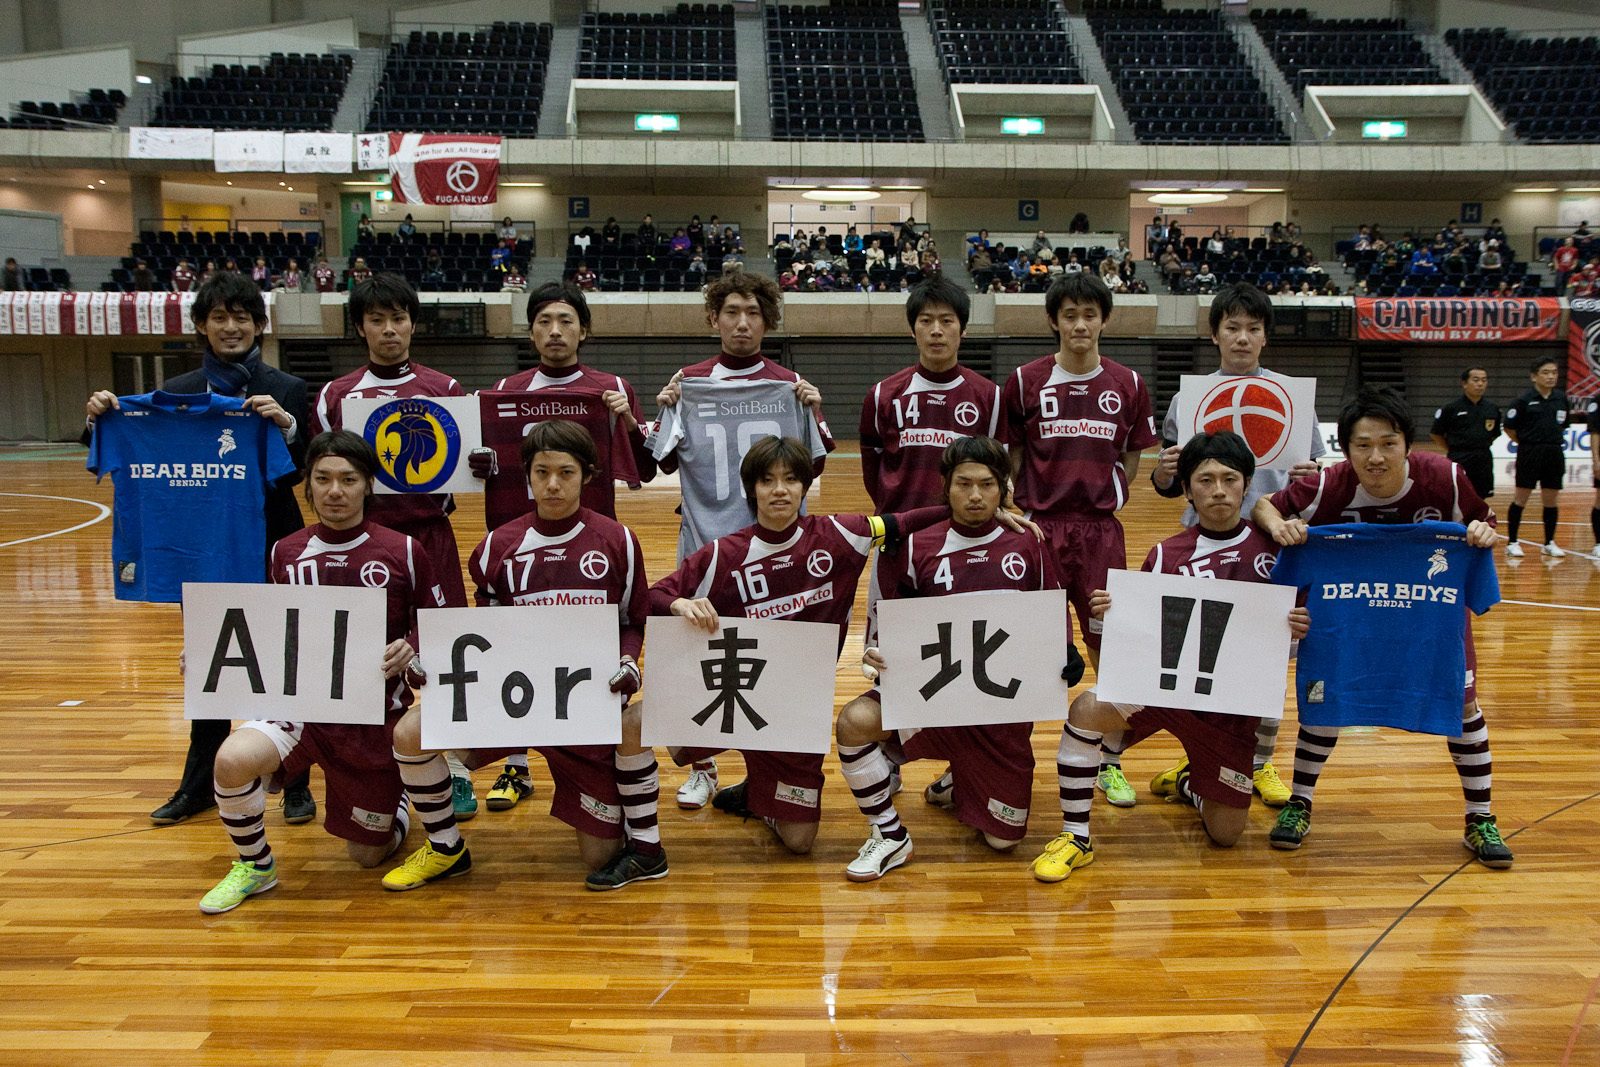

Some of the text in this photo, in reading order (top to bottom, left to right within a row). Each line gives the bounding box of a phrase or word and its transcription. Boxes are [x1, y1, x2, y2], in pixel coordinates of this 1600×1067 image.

[574, 202, 584, 214] F
[1023, 204, 1035, 217] G
[1464, 207, 1479, 220] H
[1375, 299, 1541, 329] CAFURINGA
[1410, 330, 1447, 340] WIN
[1450, 330, 1472, 340] BY
[520, 402, 588, 417] SoftBank
[720, 400, 787, 416] SoftBank
[892, 395, 920, 428] 14
[1039, 388, 1059, 419] 6
[1041, 421, 1114, 437] HottoMotto
[130, 463, 246, 480] DEAR BOYS
[169, 479, 208, 487] SENDAI
[772, 561, 794, 571] PENALTY
[966, 556, 989, 564] PENALTY
[1220, 556, 1242, 566] PENALTY
[286, 559, 320, 586] 10
[503, 553, 536, 593] 17
[933, 557, 954, 591] 4
[731, 563, 770, 604] 16
[1322, 582, 1458, 605] DEAR BOYS
[1368, 600, 1412, 609] SENDAI
[202, 608, 349, 700] All
[1159, 595, 1234, 696] !!
[918, 619, 1022, 702] 北
[439, 633, 592, 722] for
[691, 627, 769, 734] 東
